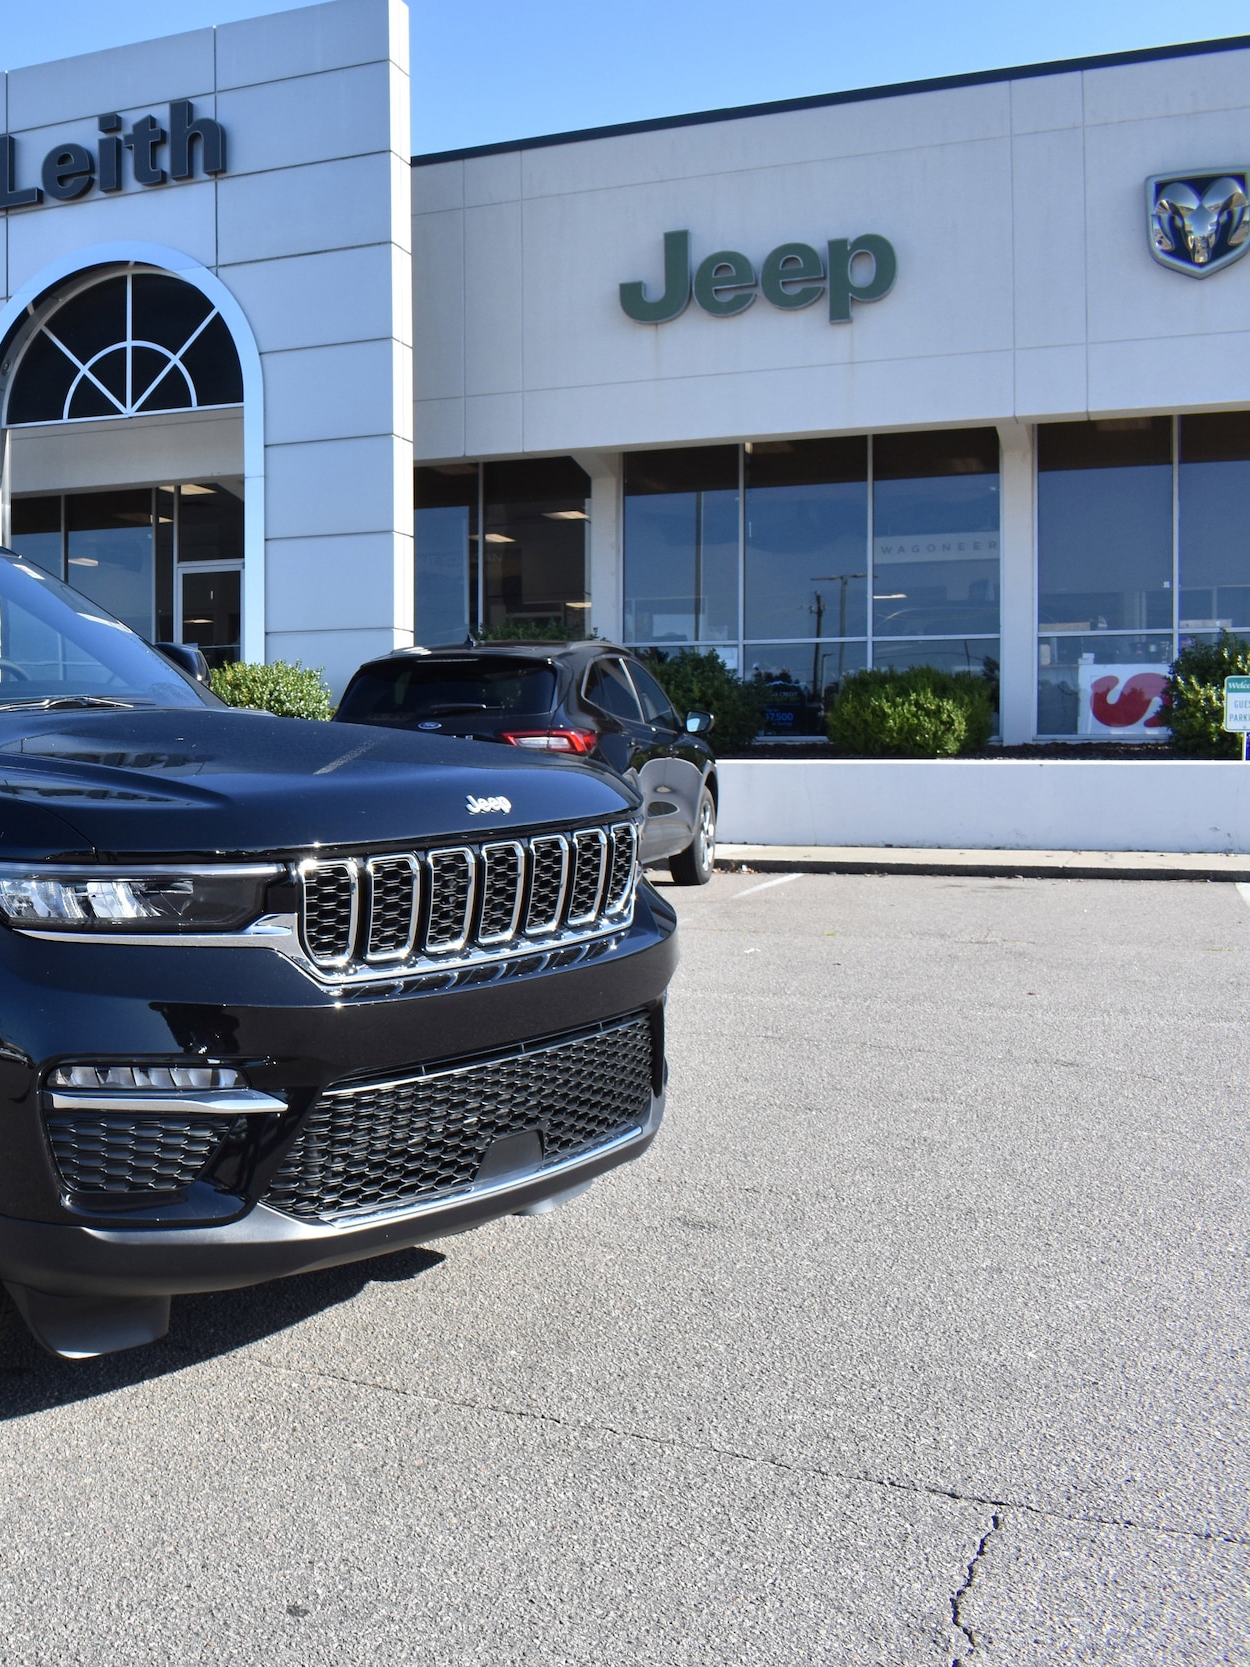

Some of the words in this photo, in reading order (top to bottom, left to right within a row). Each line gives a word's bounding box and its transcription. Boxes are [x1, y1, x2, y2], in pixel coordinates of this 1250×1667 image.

[619, 229, 897, 324] Jeep
[880, 541, 998, 555] WAGONEER
[465, 795, 512, 814] Jeep
